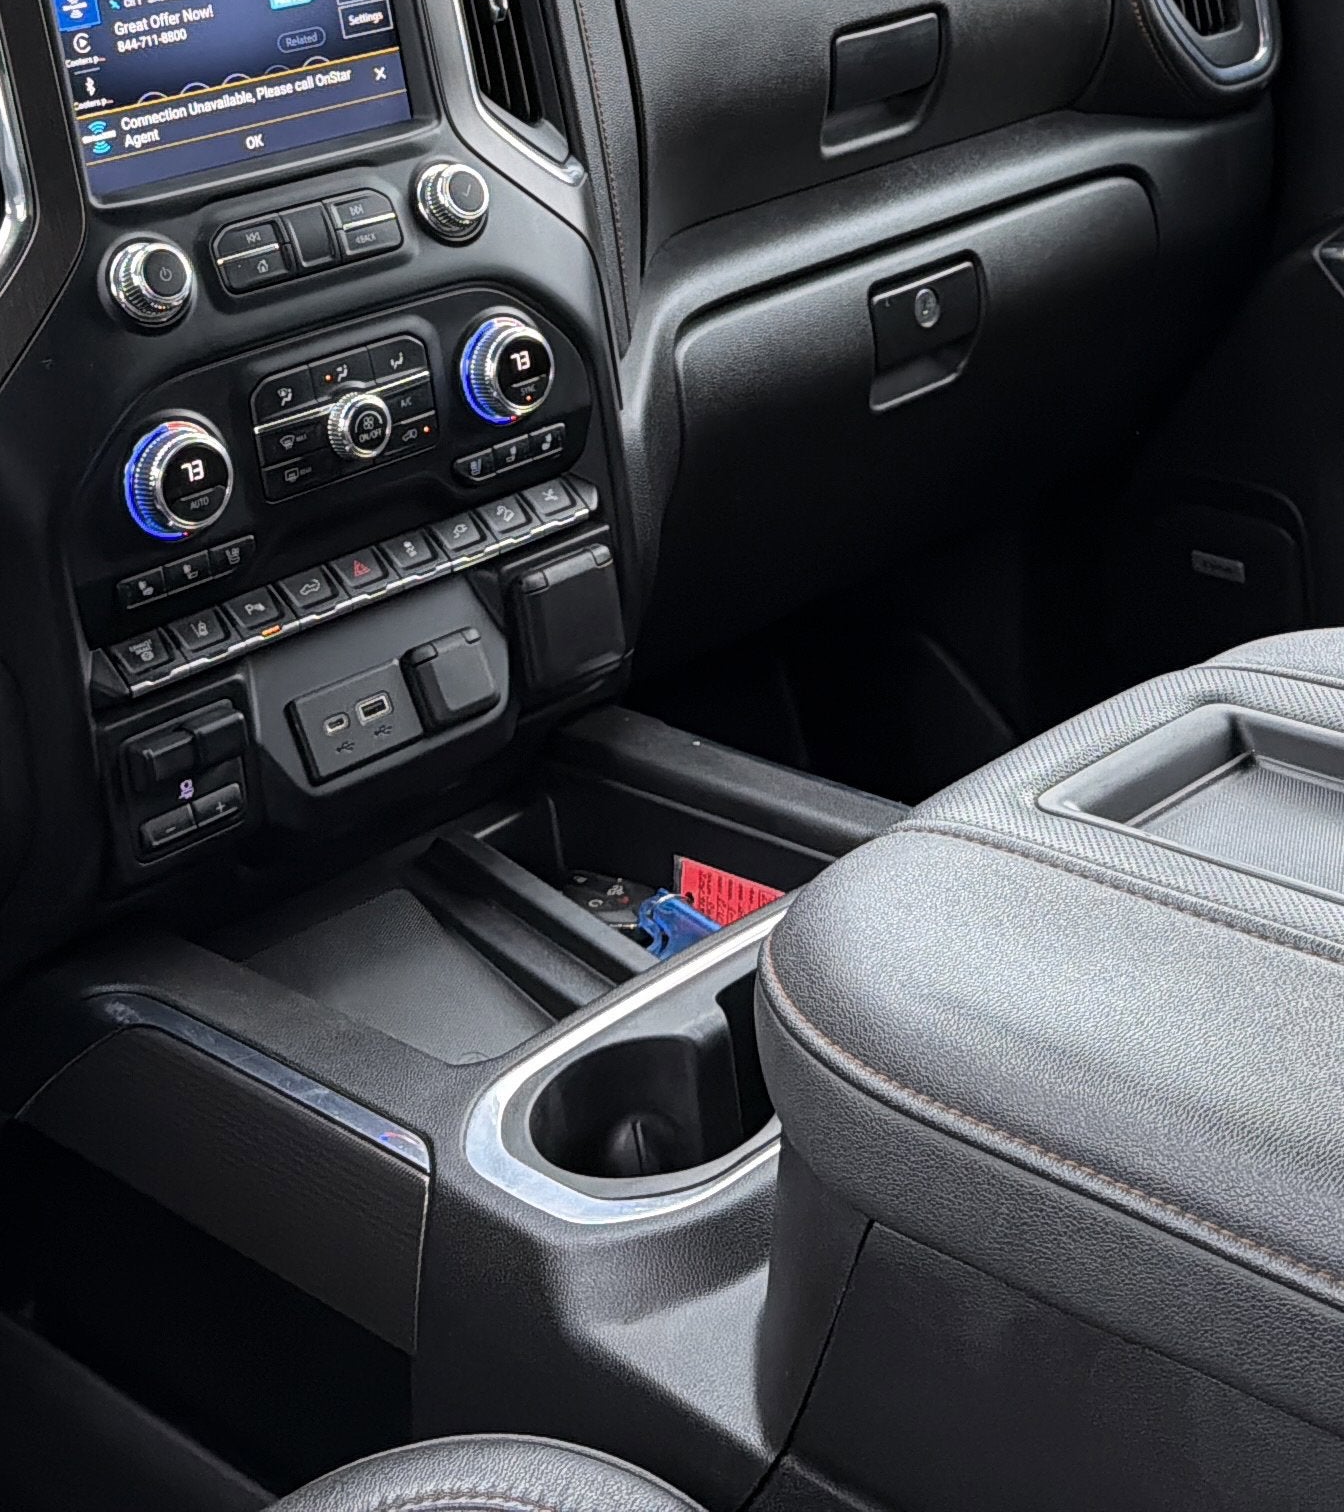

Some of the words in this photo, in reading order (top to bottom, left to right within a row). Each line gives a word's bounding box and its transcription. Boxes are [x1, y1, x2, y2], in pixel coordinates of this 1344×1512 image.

[114, 17, 149, 36] Great
[149, 12, 181, 29] Offer
[182, 4, 215, 22] Now!
[348, 10, 384, 26] Settings
[116, 28, 188, 53] 844-711-8800
[285, 32, 318, 47] Related
[120, 104, 187, 130] Connection
[187, 90, 256, 116] Unavailable,
[256, 82, 294, 101] Please
[294, 77, 314, 92] call
[314, 69, 353, 87] OnStar
[124, 129, 160, 149] Agent
[245, 133, 265, 150] OK
[360, 233, 377, 244] BACK
[509, 350, 531, 371] 73
[358, 426, 383, 443] ON/OFF
[180, 458, 205, 482] 73
[189, 496, 210, 511] AUTO
